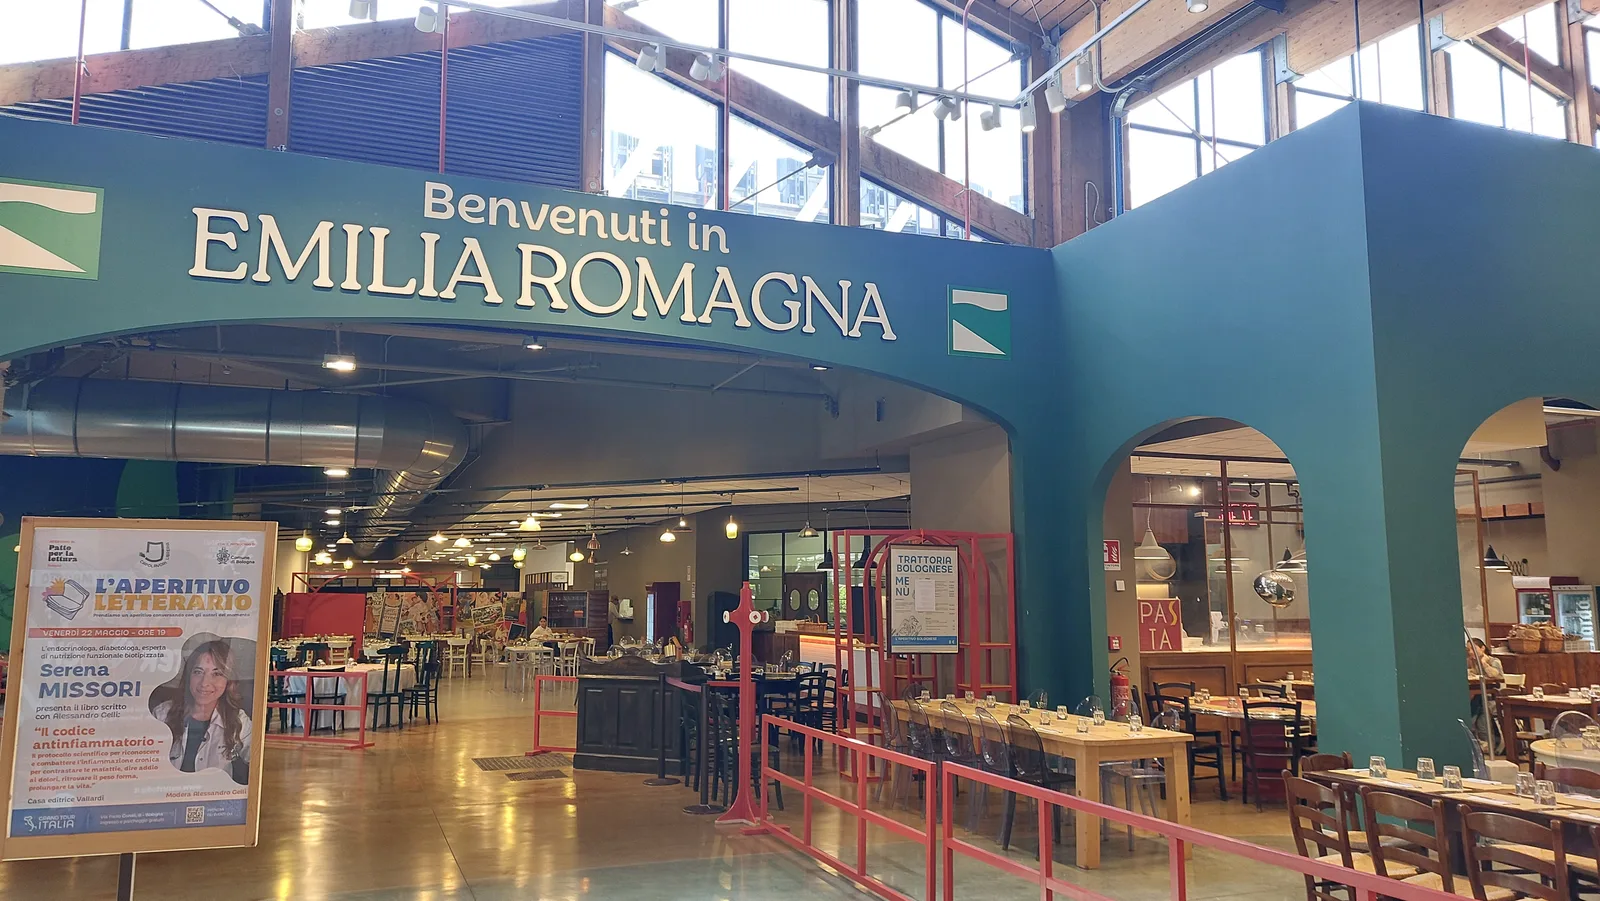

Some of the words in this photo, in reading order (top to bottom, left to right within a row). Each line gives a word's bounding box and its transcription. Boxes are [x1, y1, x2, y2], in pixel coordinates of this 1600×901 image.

[423, 181, 672, 247] Benvenuti
[687, 211, 730, 254] in
[188, 206, 503, 307] EMILIA
[516, 243, 898, 342] ROMAGNA
[897, 555, 952, 565] TRATTORIA
[896, 564, 954, 574] BOLOGNESE
[895, 576, 910, 586] ME
[895, 586, 910, 597] NÙ
[94, 594, 252, 611] LETTERARIO
[1140, 600, 1177, 626] PAS
[43, 629, 79, 637] VENERDÌ
[81, 629, 93, 637] 22
[95, 629, 130, 637] MAGGIO
[1148, 628, 1173, 650] TA
[99, 644, 141, 652] diabetologa,
[142, 644, 167, 652] esperta
[50, 652, 86, 660] nutrizione
[87, 651, 124, 659] funzionale
[124, 651, 165, 659] biotipizzata
[40, 663, 110, 678] Serena
[38, 681, 142, 699] MISSORI
[36, 704, 72, 713] presenta
[74, 704, 79, 712] il
[81, 703, 99, 711] libro
[101, 703, 127, 711] scritto
[53, 711, 99, 719] Alessandro
[52, 725, 96, 736] codice
[32, 736, 154, 750] antinfiammatorio
[38, 751, 72, 760] protocollo
[73, 750, 109, 758] scientifico
[37, 758, 76, 767] combattere
[38, 774, 60, 783] dolori,
[61, 773, 92, 782] ritrovare
[99, 773, 114, 781] peso
[28, 782, 66, 792] prolungare
[27, 797, 46, 805] Casa
[76, 794, 105, 802] Vallardi
[38, 819, 75, 830] ITALIA
